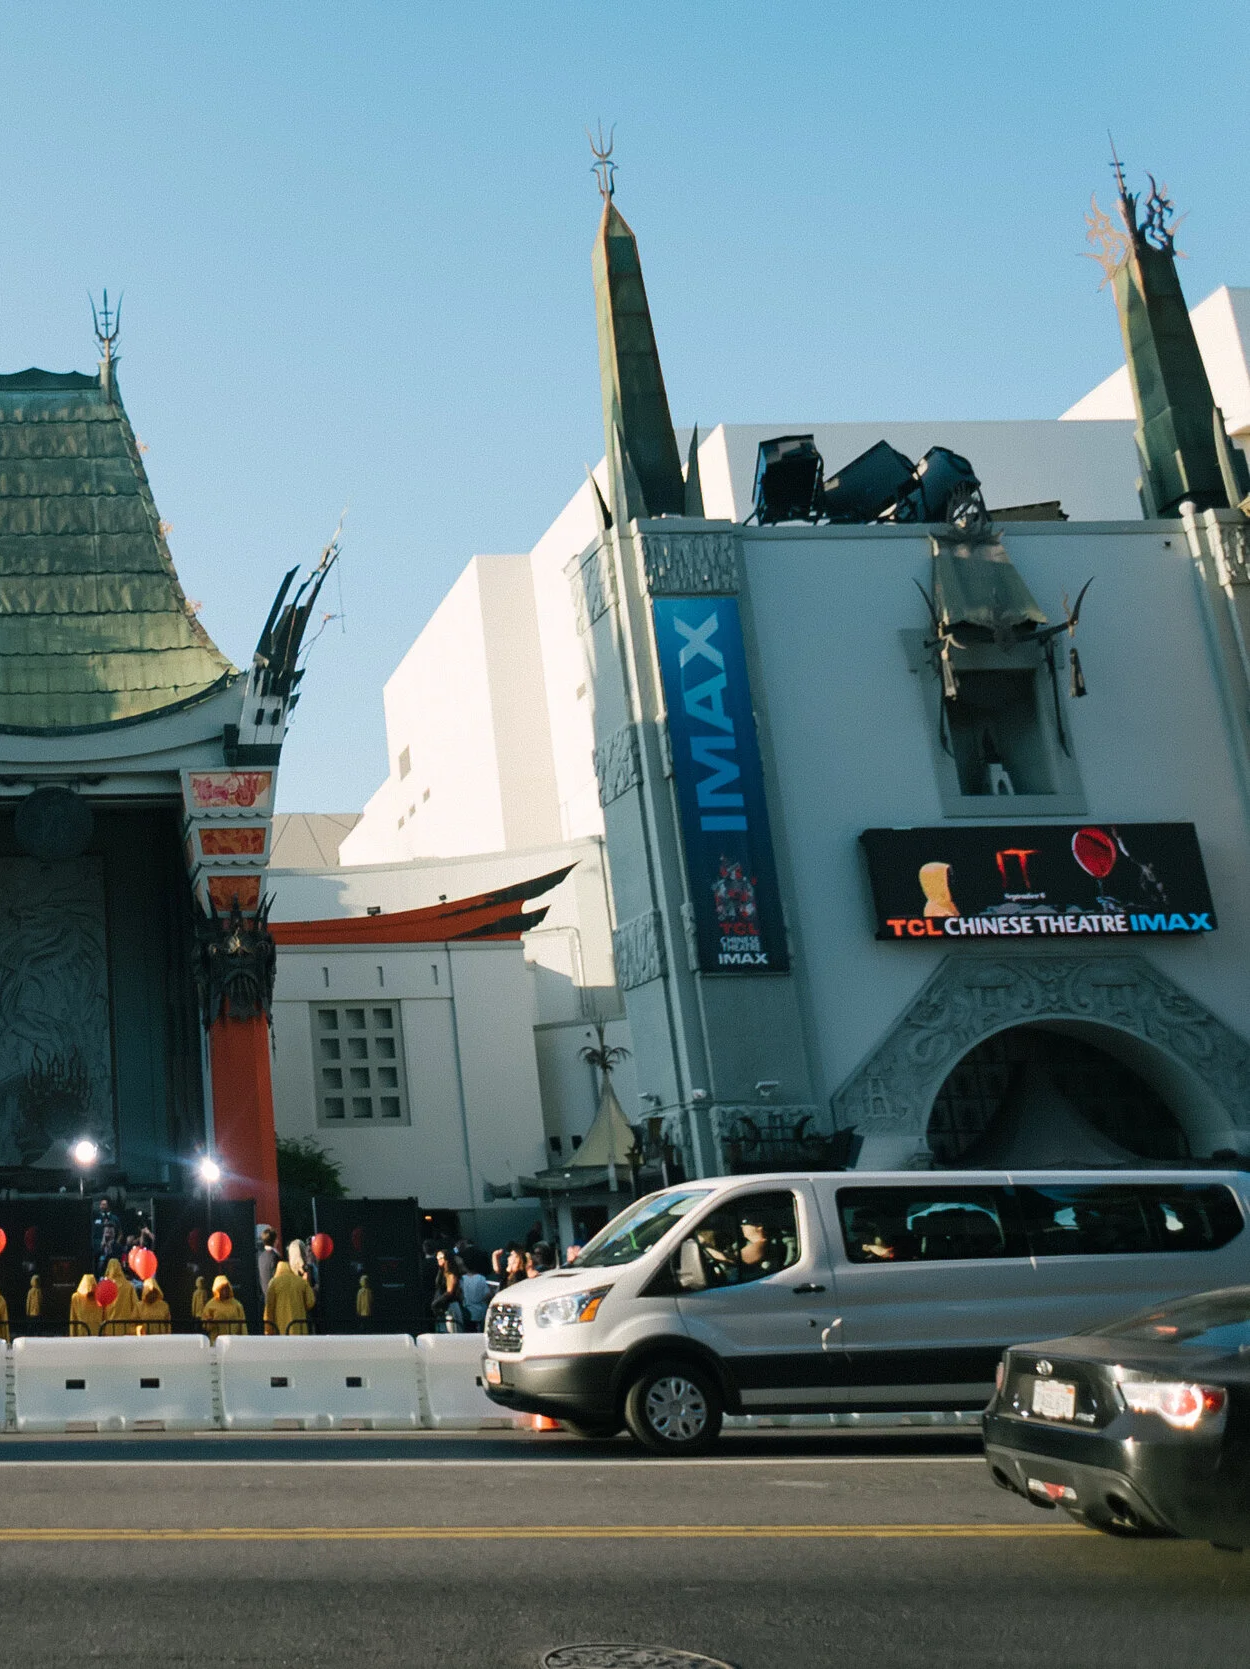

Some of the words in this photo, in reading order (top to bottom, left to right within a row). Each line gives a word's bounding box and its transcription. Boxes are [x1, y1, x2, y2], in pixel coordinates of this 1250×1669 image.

[672, 611, 748, 832] IMAX
[996, 848, 1039, 888] IT
[718, 922, 760, 935] TCL
[886, 919, 943, 936] TCL
[944, 916, 1033, 936] CHINESE
[1034, 914, 1128, 934] THEATRE
[1130, 912, 1213, 931] IMAX
[718, 953, 769, 965] IMAX
